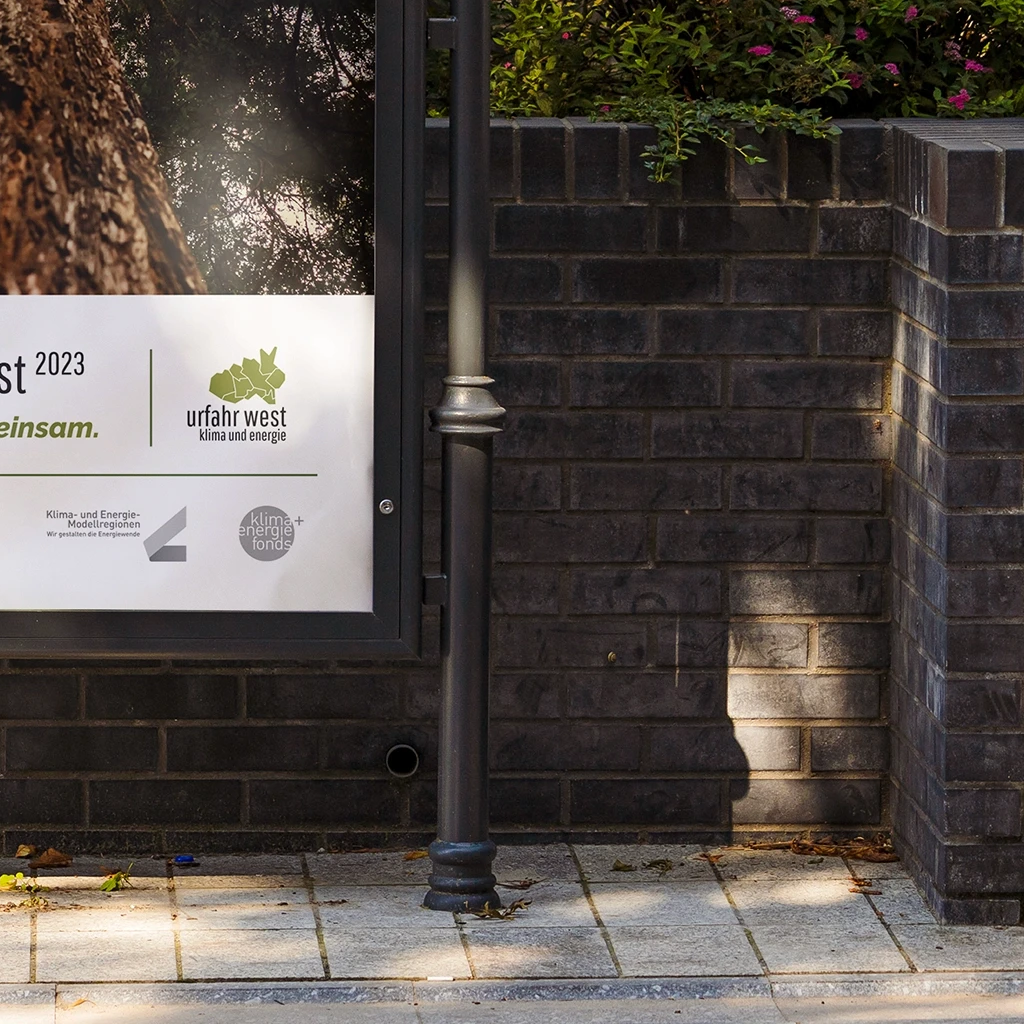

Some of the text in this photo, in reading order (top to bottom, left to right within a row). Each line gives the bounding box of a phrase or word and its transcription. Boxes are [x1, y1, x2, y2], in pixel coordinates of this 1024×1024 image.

[35, 351, 85, 376] 2023
[187, 405, 287, 427] urfahr west
[199, 429, 287, 444] klima und energie
[46, 510, 140, 521] Klima- und Energie-
[67, 519, 141, 531] Modellregionen
[98, 531, 141, 539] Energiewende
[239, 525, 292, 540] energie
[252, 536, 292, 550] fonds
